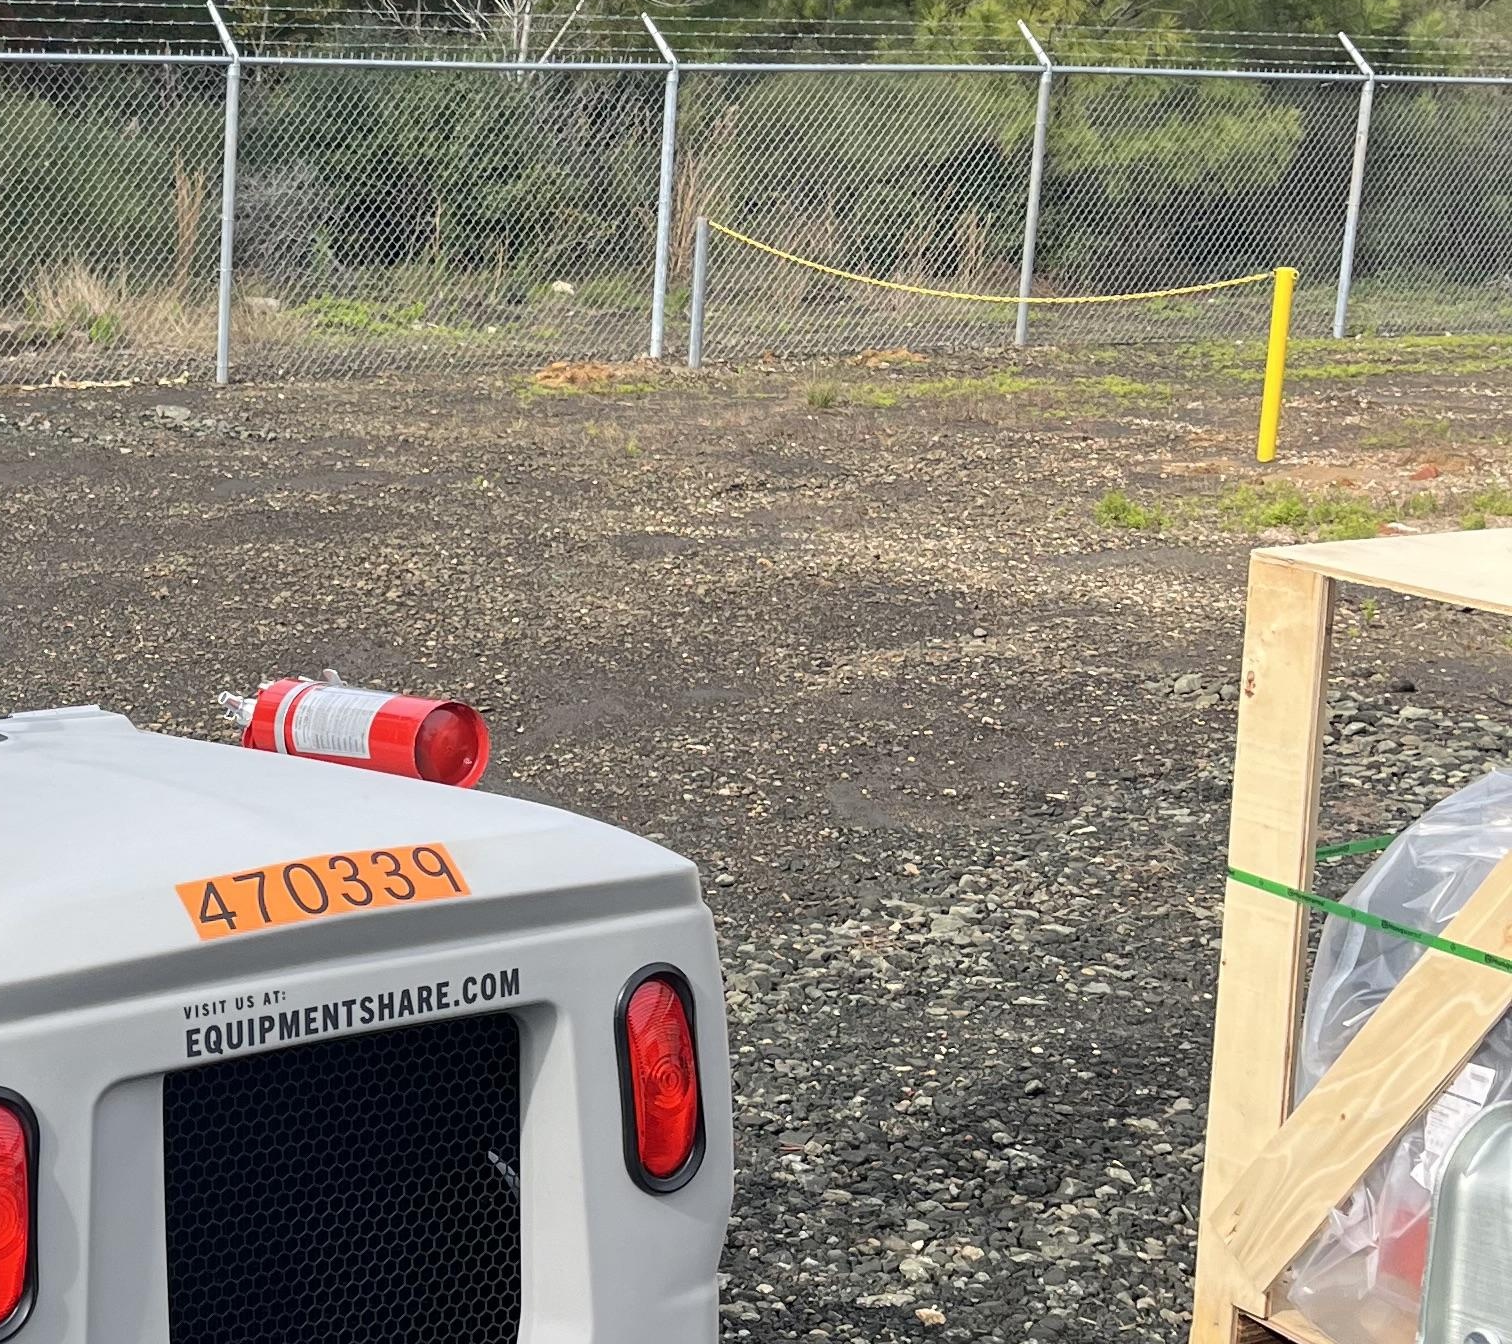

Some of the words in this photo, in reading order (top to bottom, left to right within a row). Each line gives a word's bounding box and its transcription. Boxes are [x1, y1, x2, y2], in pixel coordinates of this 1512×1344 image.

[199, 847, 461, 930] 470339
[184, 1000, 226, 1019] VISIT
[235, 995, 255, 1010] US
[263, 990, 287, 1005] AT:
[186, 968, 520, 1057] EQUIPMENTSHARE.COM
